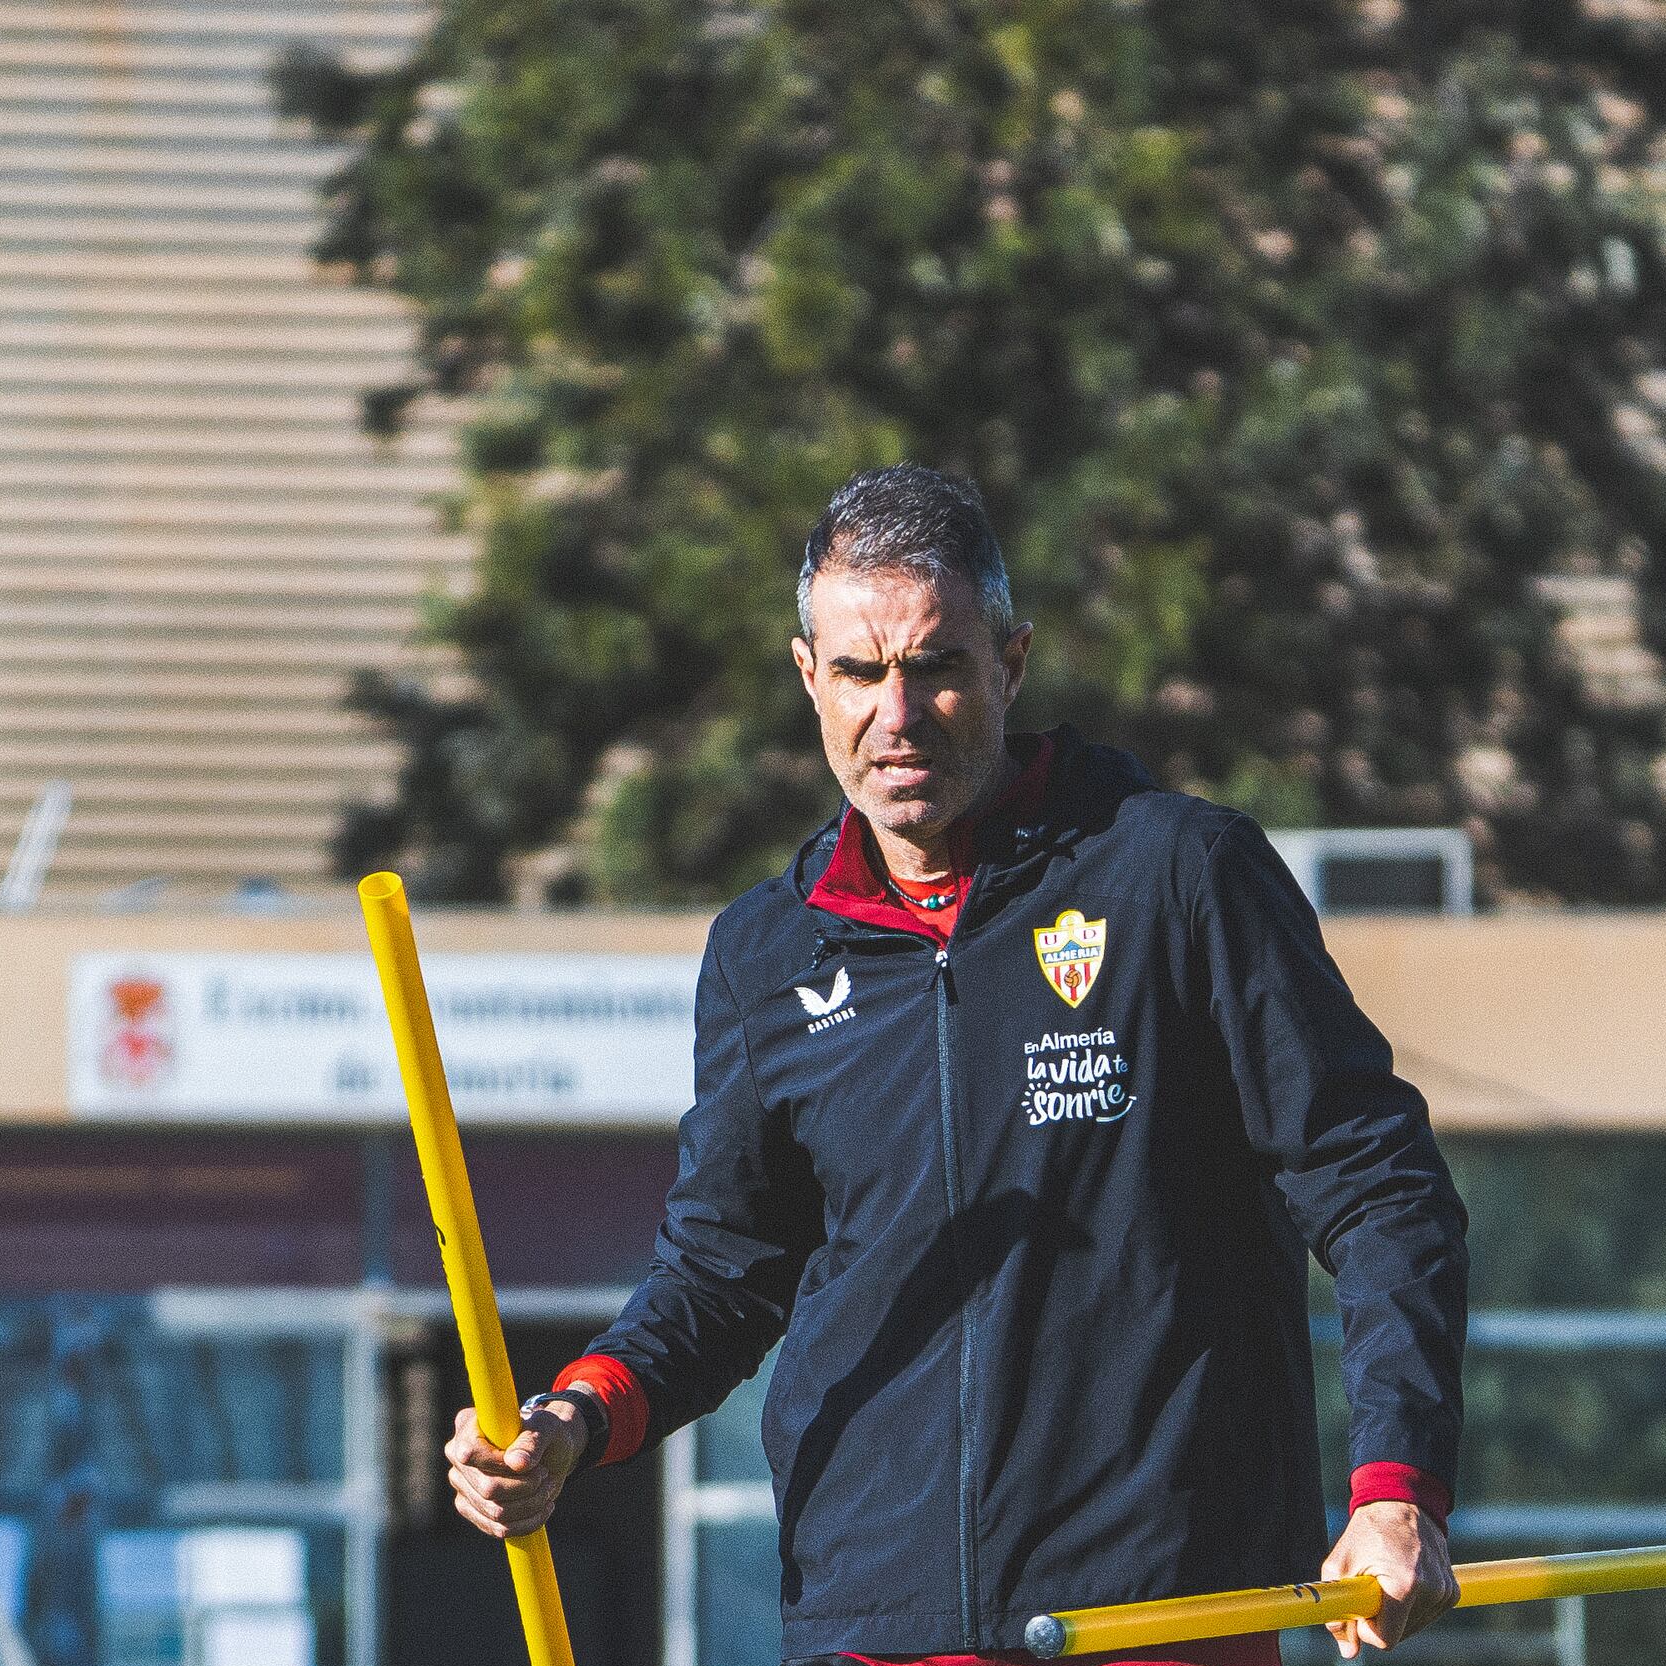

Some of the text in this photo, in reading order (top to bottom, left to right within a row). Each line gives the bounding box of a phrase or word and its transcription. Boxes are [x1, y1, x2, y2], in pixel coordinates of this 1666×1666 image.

[1044, 928, 1097, 946] U D
[1044, 947, 1100, 963] ALMERIA
[807, 1006, 857, 1034] CASTORE
[1024, 1027, 1116, 1054] En Almería
[1027, 1048, 1129, 1084] la vida te
